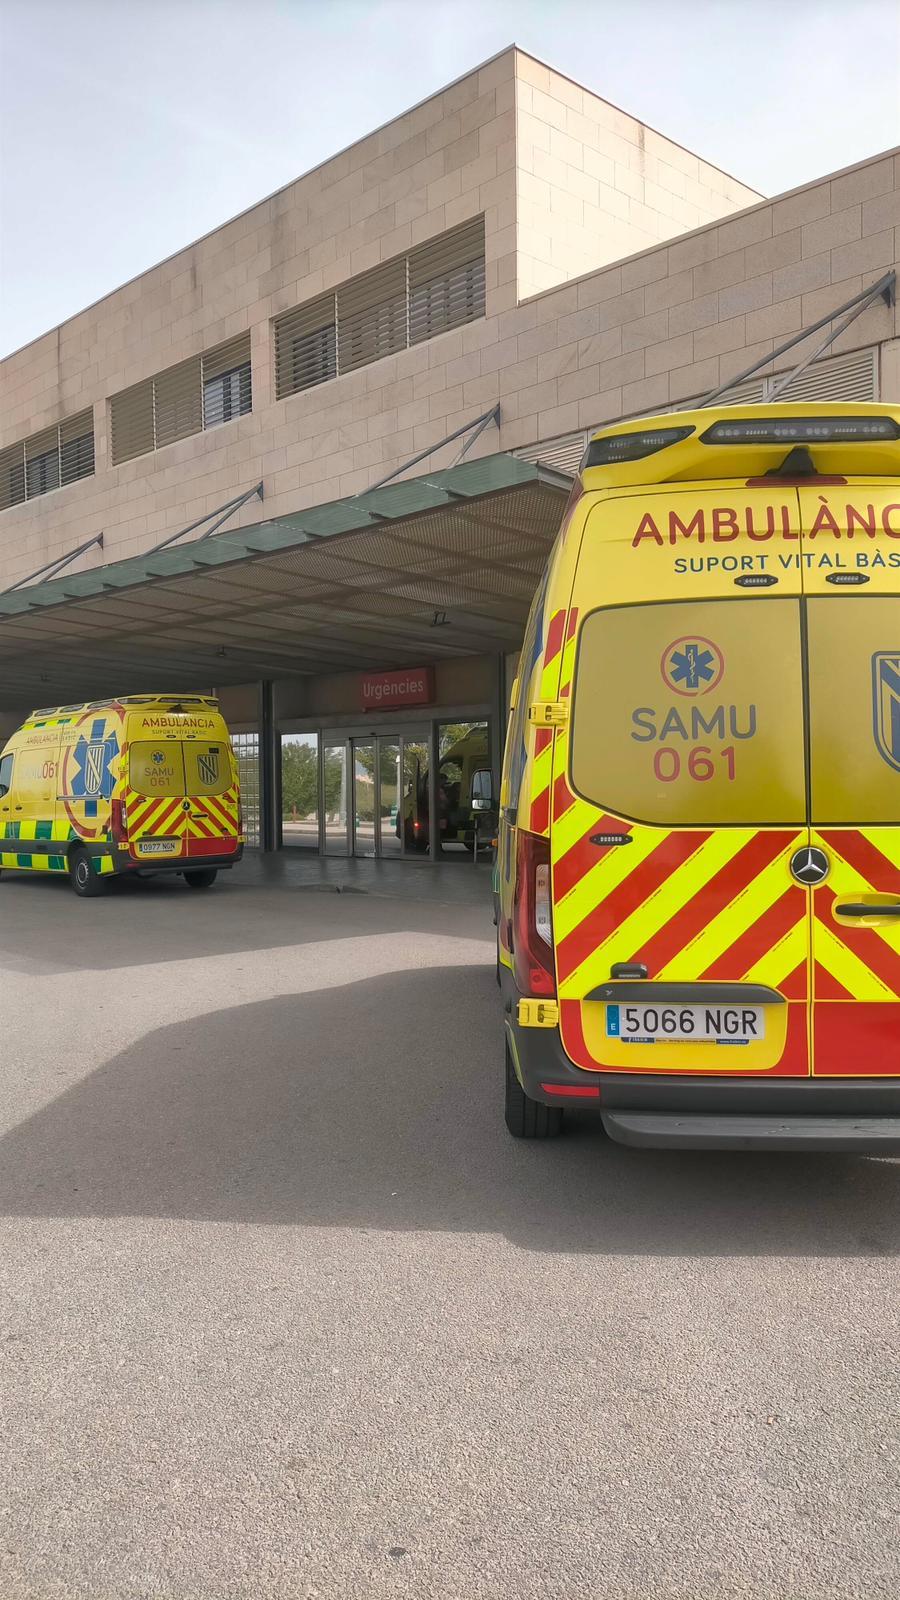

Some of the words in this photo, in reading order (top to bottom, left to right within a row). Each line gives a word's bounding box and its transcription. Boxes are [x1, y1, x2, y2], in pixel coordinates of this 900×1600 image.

[673, 554, 769, 573] SUPORT
[778, 552, 846, 569] VITAL
[363, 678, 424, 699] Urgències
[630, 704, 757, 741] SAMU
[42, 762, 59, 779] 061
[144, 767, 174, 777] SAMU
[653, 745, 736, 783] 061
[150, 777, 170, 787] 061
[610, 1023, 616, 1031] E
[625, 1008, 695, 1034] 5066
[705, 1009, 758, 1035] NGR
